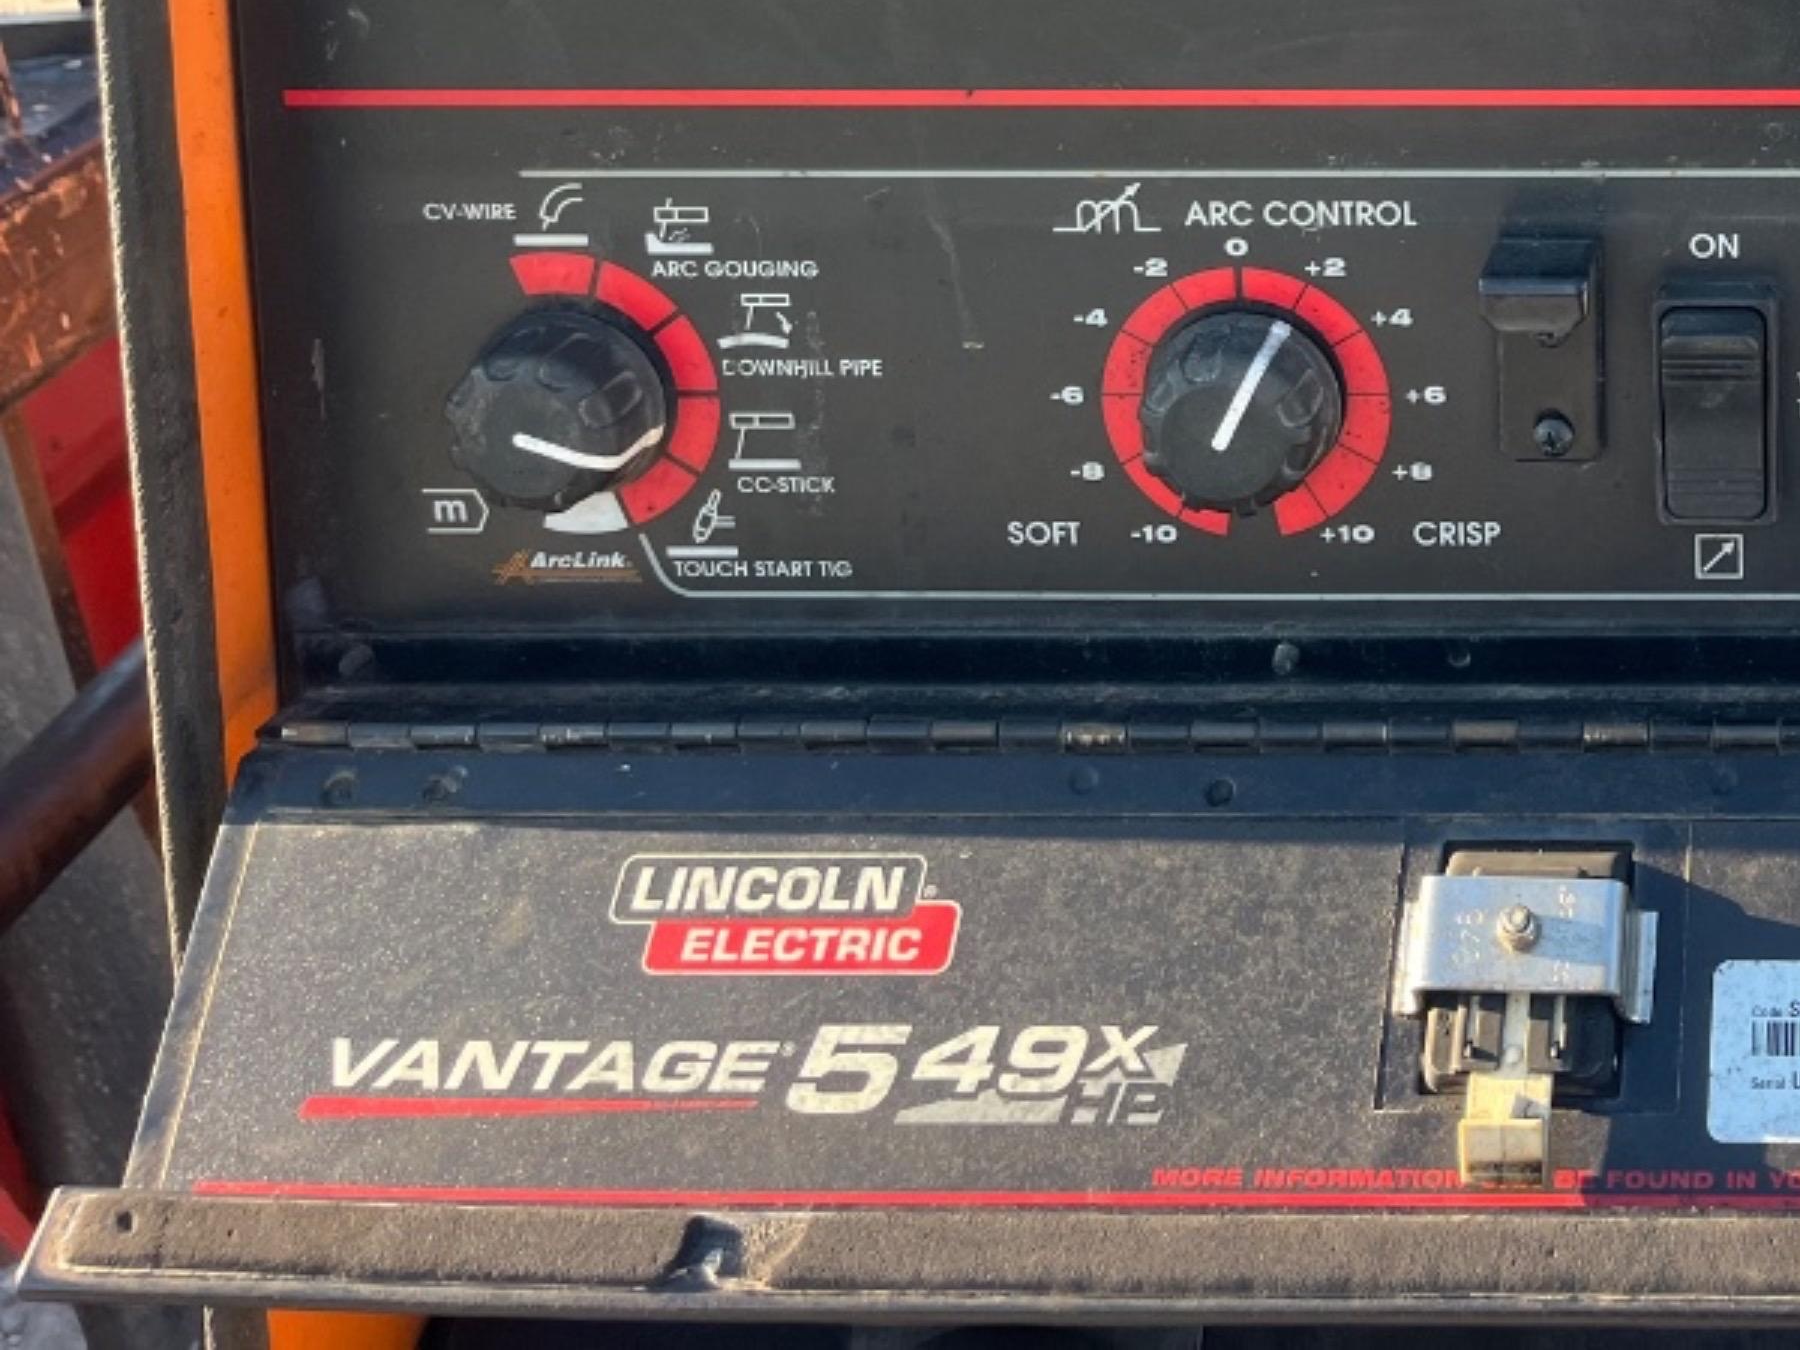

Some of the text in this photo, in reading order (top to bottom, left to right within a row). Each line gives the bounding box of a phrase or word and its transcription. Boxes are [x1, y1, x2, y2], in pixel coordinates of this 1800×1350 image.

[422, 202, 517, 221] CV-WIRE
[1184, 201, 1418, 228] ARC CONTROL
[1224, 238, 1249, 257] 0
[1689, 233, 1741, 259] ON
[652, 260, 819, 278] ARC GOUGING
[1132, 258, 1169, 278] -2
[1304, 258, 1347, 278] +2
[1073, 308, 1108, 328] -4
[1371, 308, 1414, 328] +4
[722, 359, 883, 378] DOWNHILL PIPE
[1050, 385, 1085, 405] -6
[1405, 385, 1447, 405] +6
[1070, 462, 1105, 482] -8
[1391, 462, 1433, 482] +8
[737, 475, 835, 494] CC-STICK
[1007, 522, 1081, 546] SOFT
[1130, 524, 1178, 544] -10
[1319, 524, 1375, 545] +10
[1413, 522, 1501, 546] CRISP
[674, 559, 854, 578] TOUCH START TIG
[630, 864, 907, 913] LINCOLN
[680, 929, 925, 963] ELECTRIC
[1151, 1168, 1243, 1190] MORE
[1608, 1169, 1714, 1189] FOUND
[1724, 1170, 1757, 1190] IN
